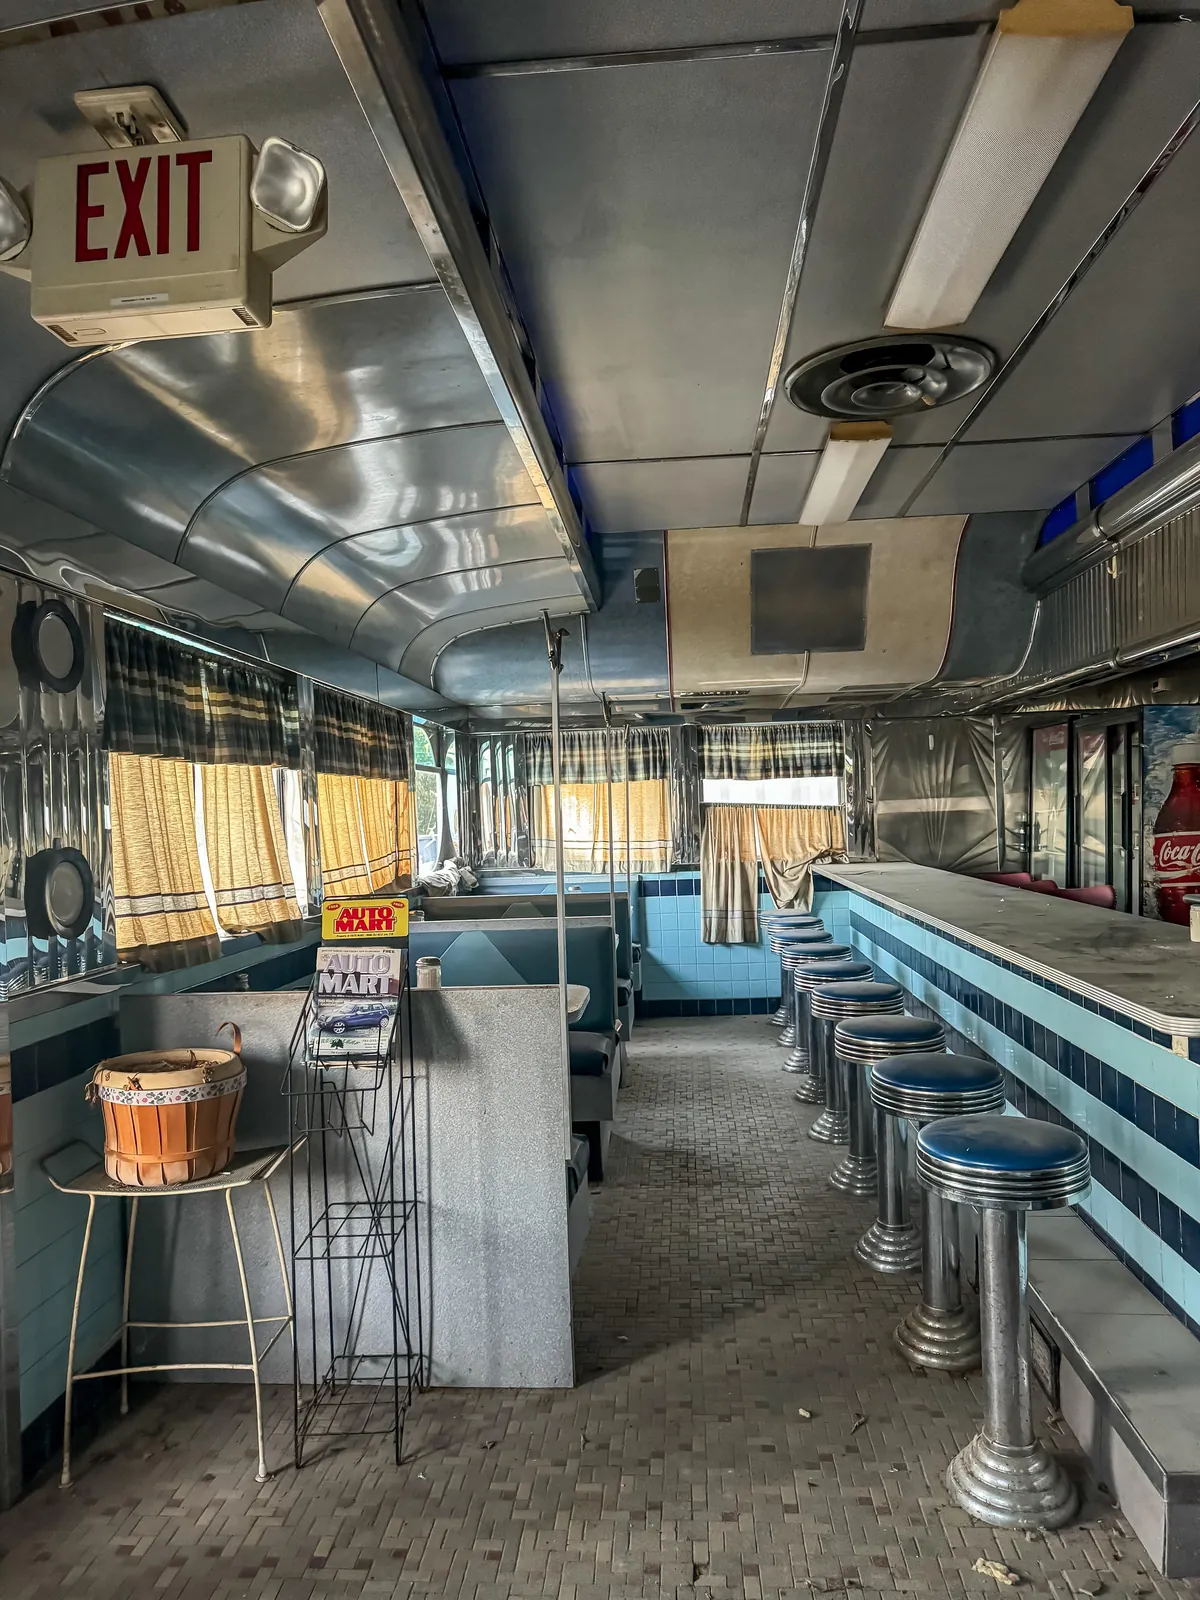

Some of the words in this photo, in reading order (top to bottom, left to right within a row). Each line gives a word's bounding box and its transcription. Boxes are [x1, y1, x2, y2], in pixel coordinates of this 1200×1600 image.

[75, 150, 213, 262] EXIT
[1159, 840, 1200, 867] Coca-C
[339, 907, 393, 920] AUTO
[335, 919, 396, 932] MART
[323, 953, 391, 974] AUTO
[318, 973, 394, 994] MART
